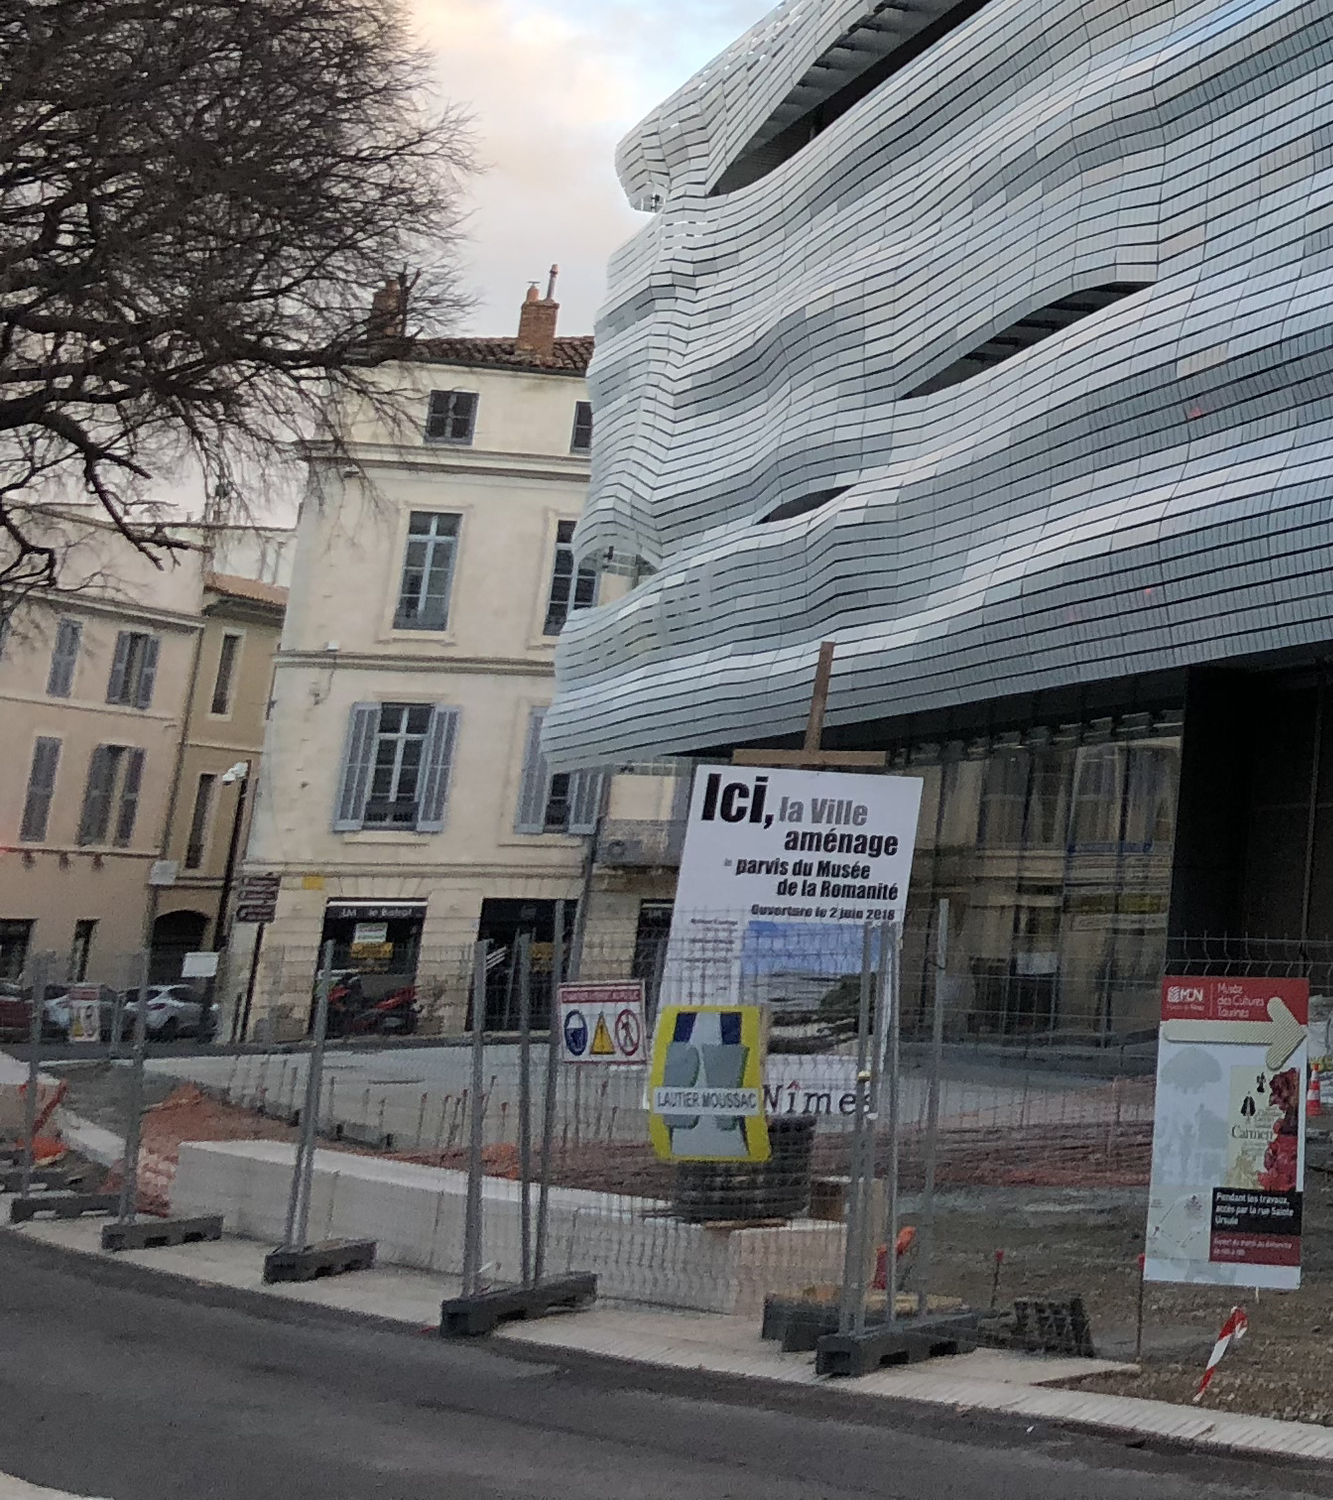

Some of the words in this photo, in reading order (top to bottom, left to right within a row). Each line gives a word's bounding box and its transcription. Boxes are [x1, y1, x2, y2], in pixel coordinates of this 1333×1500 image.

[701, 773, 774, 829] Ici,
[779, 797, 804, 822] la
[811, 798, 868, 826] Ville
[784, 829, 899, 858] aménage
[735, 858, 788, 876] parvis
[792, 859, 813, 876] du
[816, 861, 870, 879] Musée
[776, 879, 798, 896] de
[801, 880, 816, 897] la
[820, 881, 898, 901] Romanité
[750, 904, 811, 917] Ouverture
[814, 907, 828, 917] le
[829, 908, 838, 918] 2
[867, 909, 895, 921] 2018
[1216, 1192, 1246, 1202] Pendant
